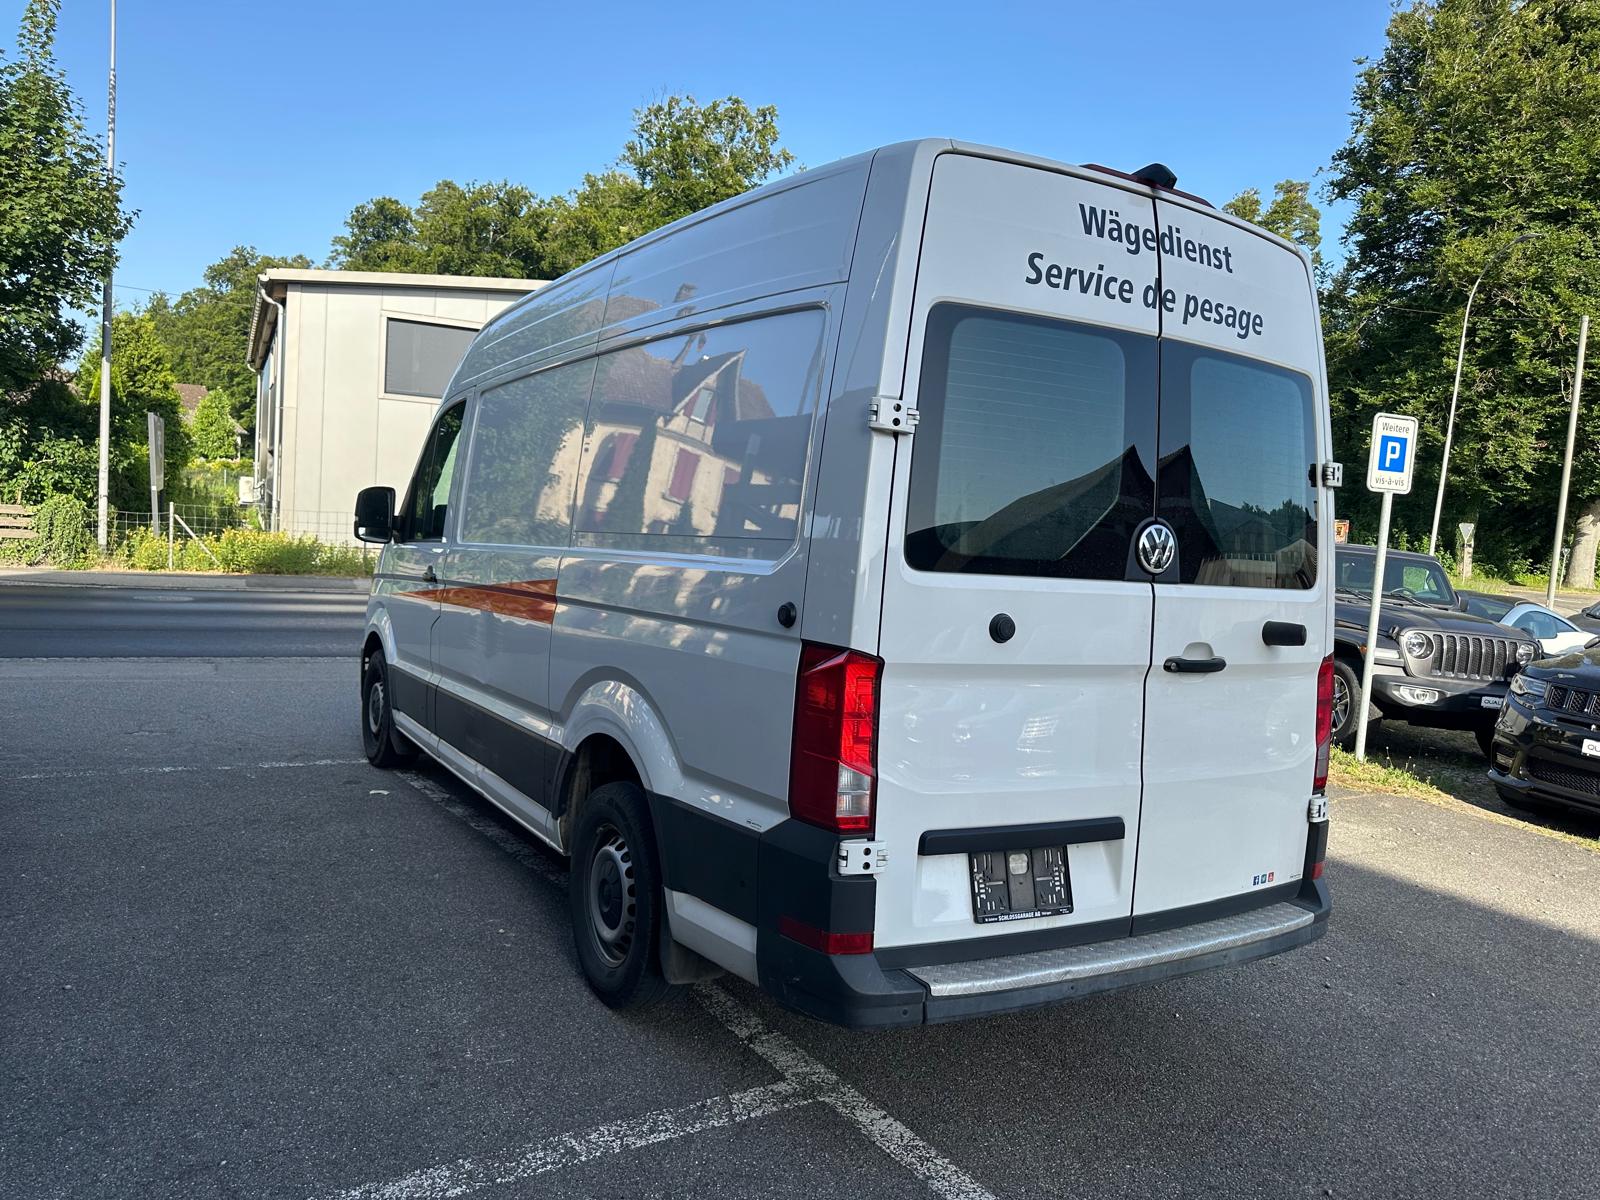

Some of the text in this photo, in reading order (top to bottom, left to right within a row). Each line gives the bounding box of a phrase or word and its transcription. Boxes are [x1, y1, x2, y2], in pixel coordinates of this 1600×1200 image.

[1078, 203, 1233, 273] Wägedienst
[1025, 252, 1264, 339] Service de pesage
[1382, 422, 1410, 433] Weitere
[1385, 441, 1400, 468] P
[998, 911, 1034, 921] SCHLOSSGARAGE
